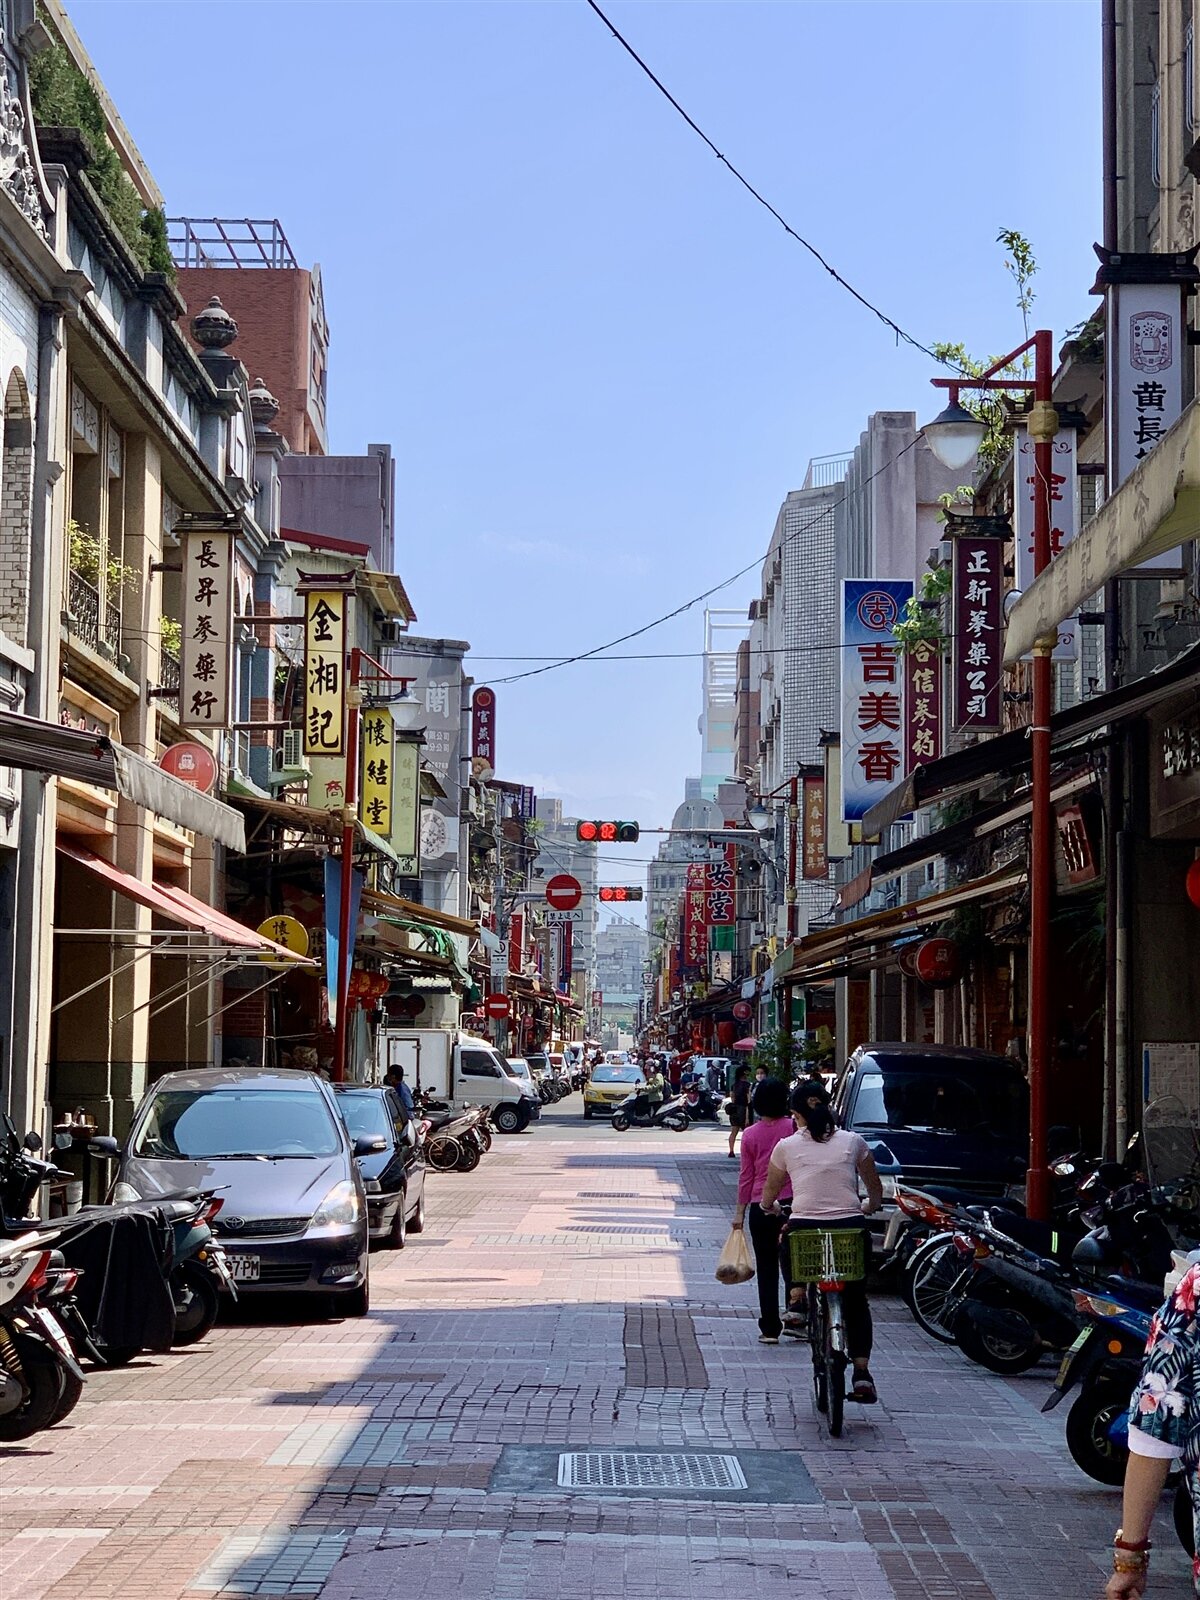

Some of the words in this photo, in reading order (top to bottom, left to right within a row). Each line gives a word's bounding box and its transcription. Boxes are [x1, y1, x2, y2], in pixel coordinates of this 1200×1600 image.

[308, 599, 340, 748] 金湘記
[858, 642, 900, 781] 吉美香
[365, 718, 390, 826] 懷結堂
